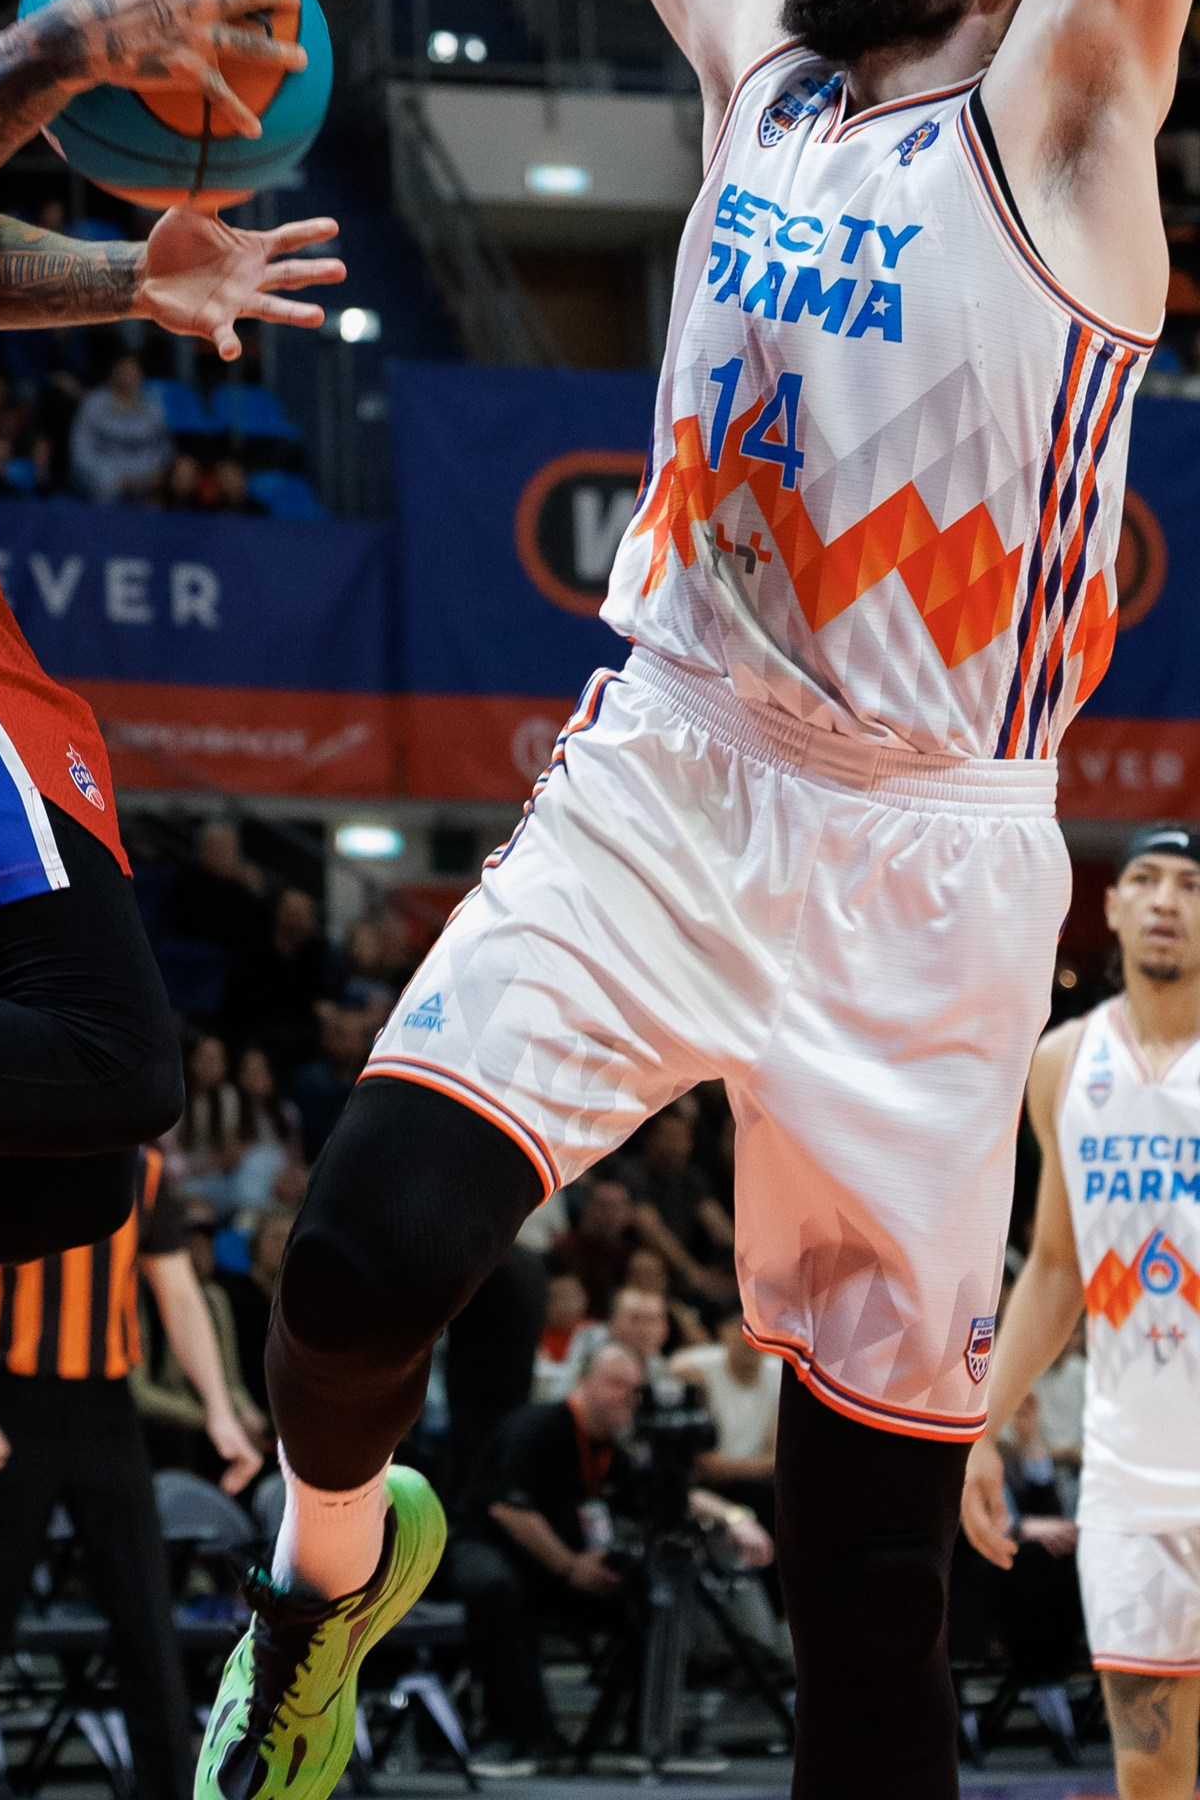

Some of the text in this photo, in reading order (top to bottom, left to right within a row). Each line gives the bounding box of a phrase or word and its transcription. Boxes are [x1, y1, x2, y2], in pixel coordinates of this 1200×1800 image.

[709, 357, 805, 492] 14
[1079, 1135, 1200, 1163] BETCIT
[1085, 1169, 1200, 1204] PARM
[1139, 1229, 1182, 1296] 6
